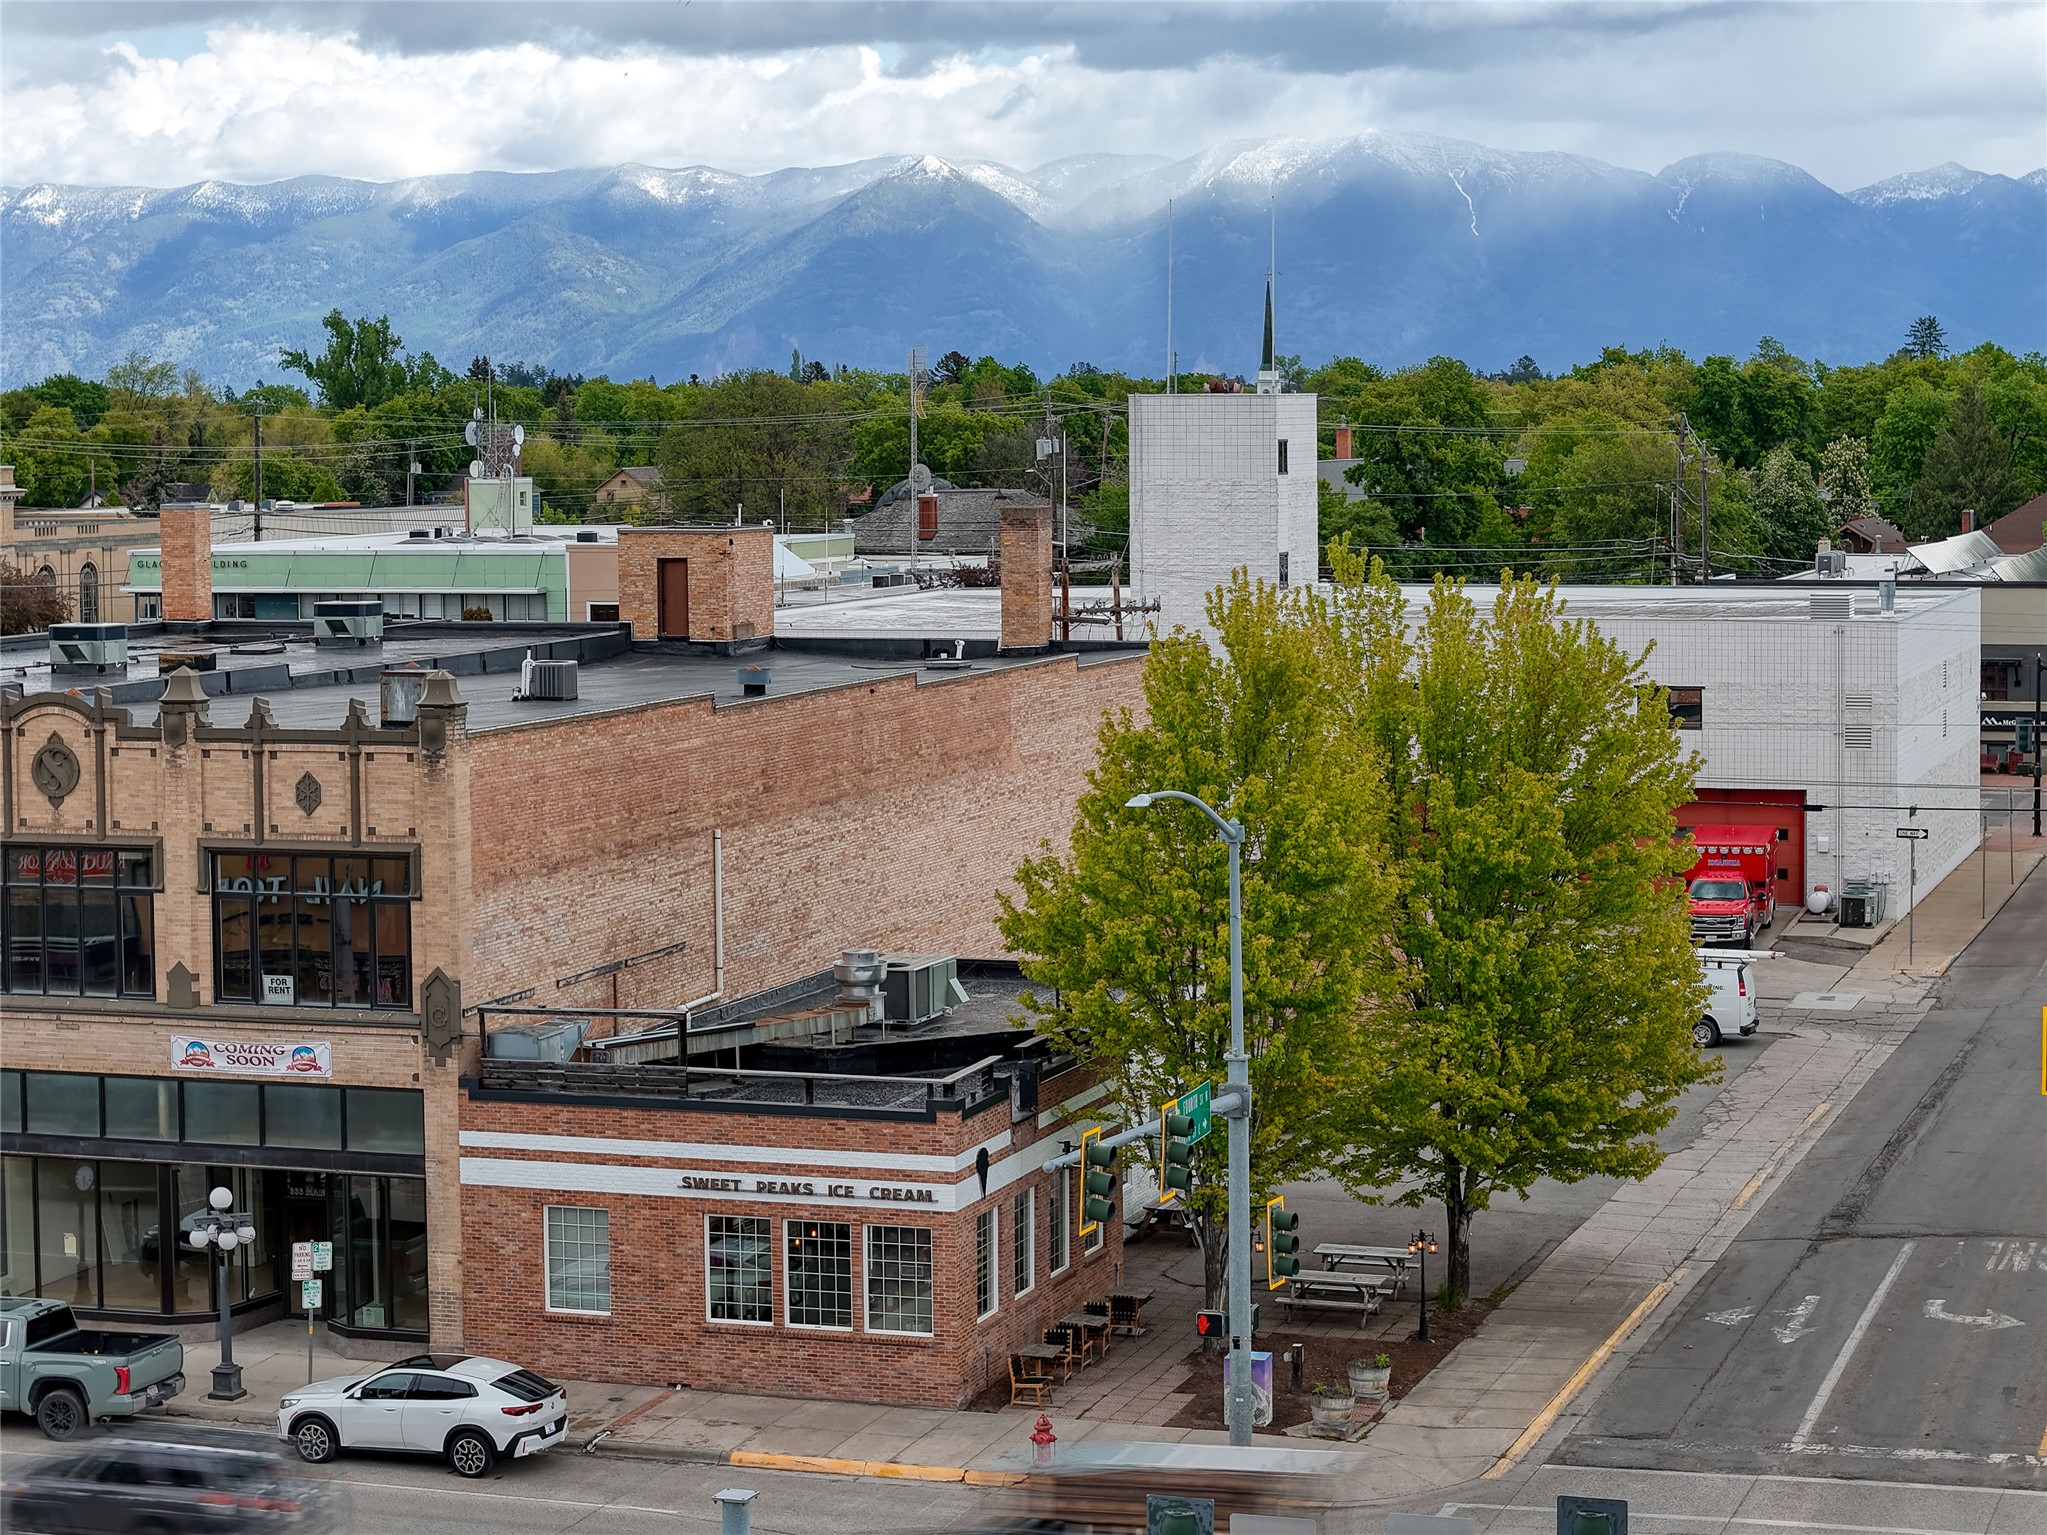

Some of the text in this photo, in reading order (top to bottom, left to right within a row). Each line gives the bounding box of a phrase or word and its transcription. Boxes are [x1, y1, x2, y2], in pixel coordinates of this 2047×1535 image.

[213, 560, 247, 569] LDING
[270, 978, 288, 986] FOR
[268, 986, 291, 995] RENT
[213, 1043, 286, 1056] COMING
[226, 1055, 276, 1067] SOON
[681, 1176, 933, 1202] SWEET PEAKS ICE CREAM
